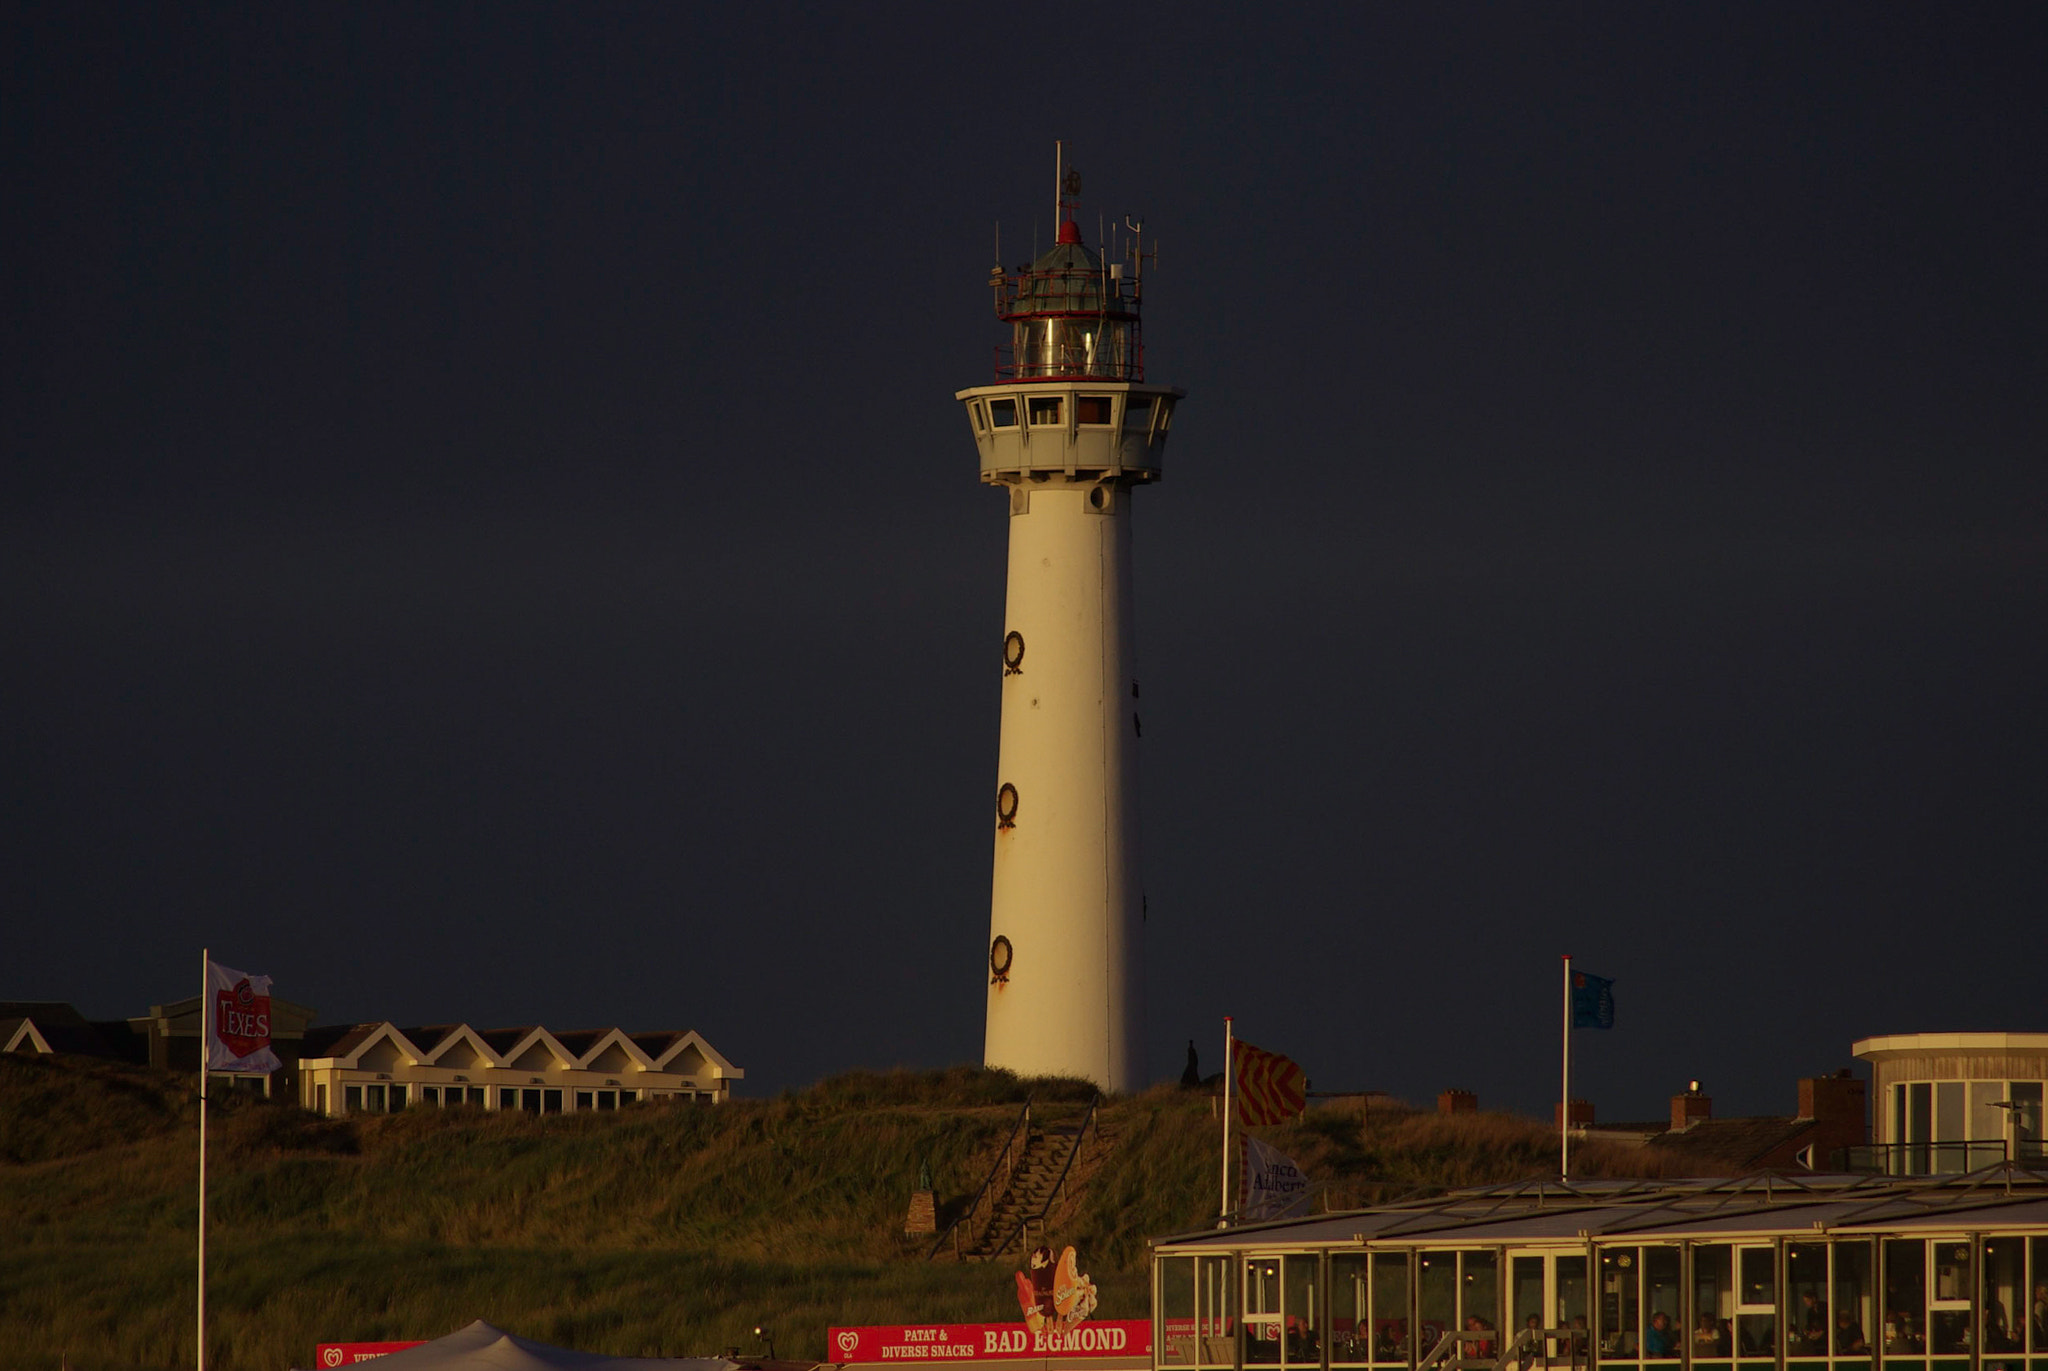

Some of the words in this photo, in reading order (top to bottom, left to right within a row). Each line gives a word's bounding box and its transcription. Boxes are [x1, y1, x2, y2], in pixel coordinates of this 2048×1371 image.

[220, 1000, 269, 1037] TEXES
[904, 1329, 937, 1342] PATAT
[939, 1329, 948, 1342] &
[984, 1330, 1028, 1353] BAD
[1033, 1328, 1127, 1352] EGMOND
[882, 1345, 929, 1358] DIVERSE
[931, 1344, 975, 1357] SNACKS
